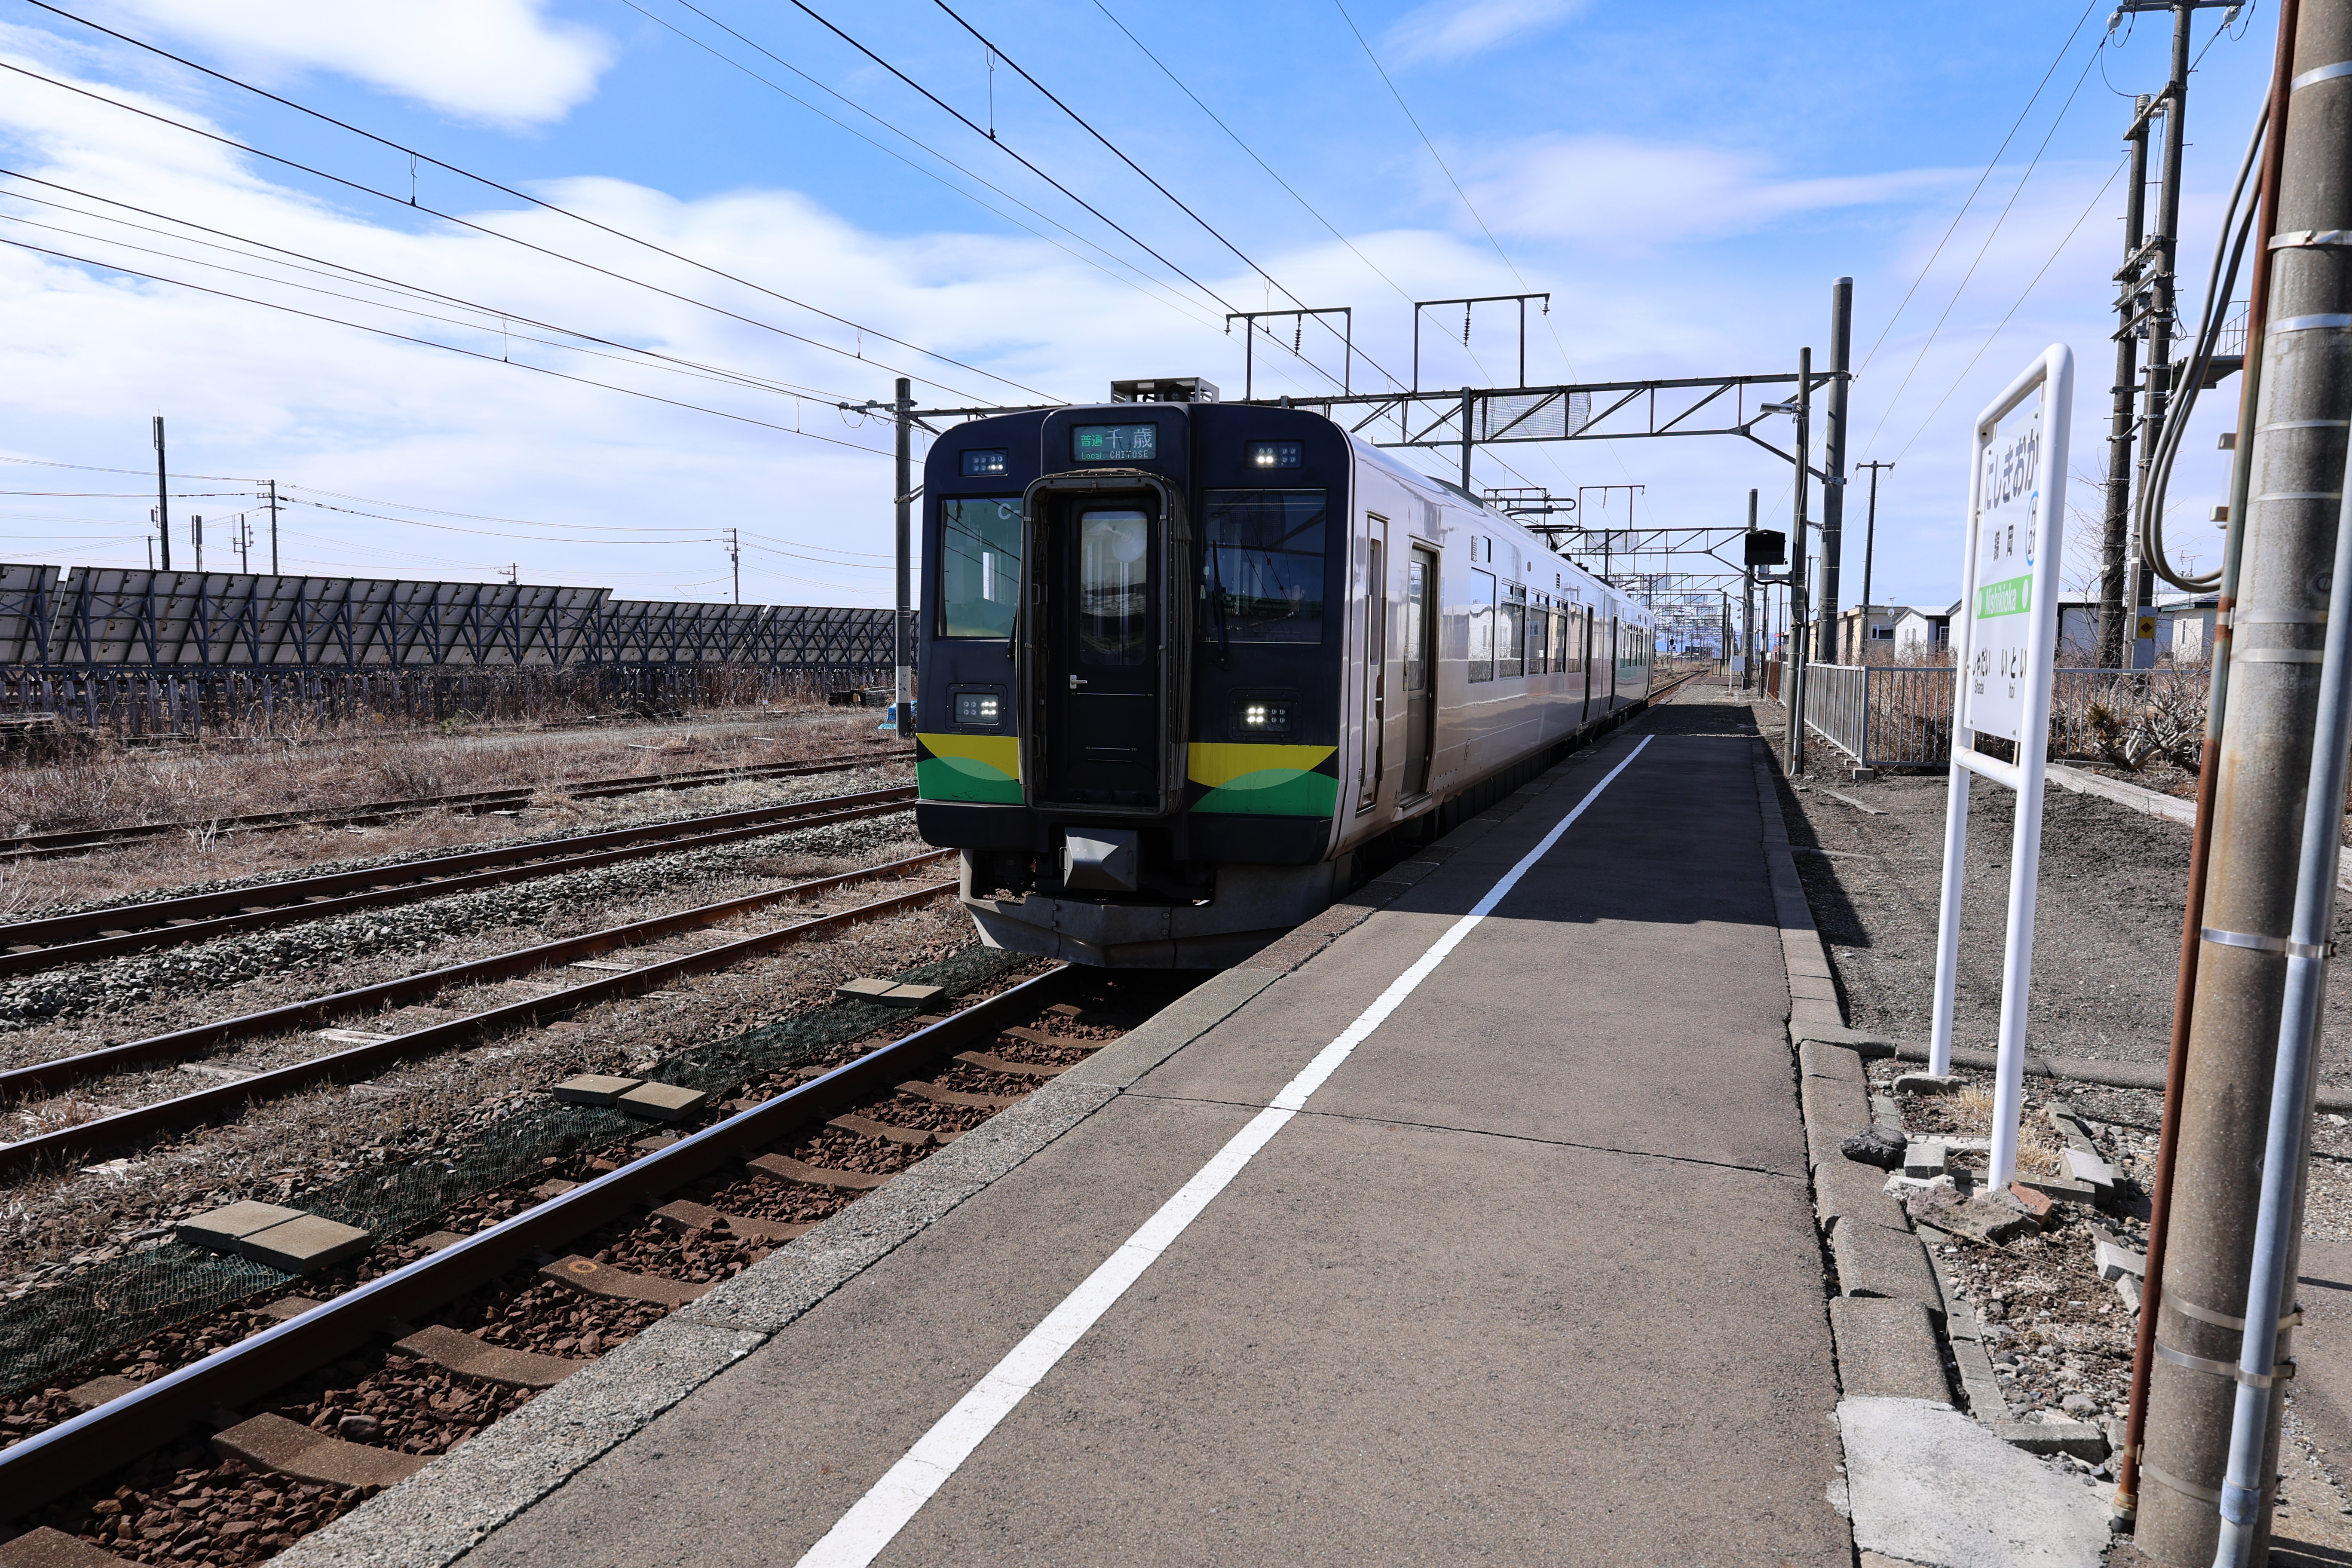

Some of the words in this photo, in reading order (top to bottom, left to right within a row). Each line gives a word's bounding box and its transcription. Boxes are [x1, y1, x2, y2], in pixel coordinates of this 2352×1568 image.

[1080, 435, 1102, 446] 普通
[1106, 428, 1152, 448] 千歳
[1110, 450, 1148, 459] CHITOSE
[1986, 428, 2039, 510] にしきおか
[2031, 500, 2037, 527] H
[2027, 528, 2036, 554] 21
[1985, 582, 2016, 615] Nishikioka
[1972, 647, 1991, 677] しゃだい
[2001, 646, 2027, 679] いとい
[1974, 679, 1985, 695] Shadai
